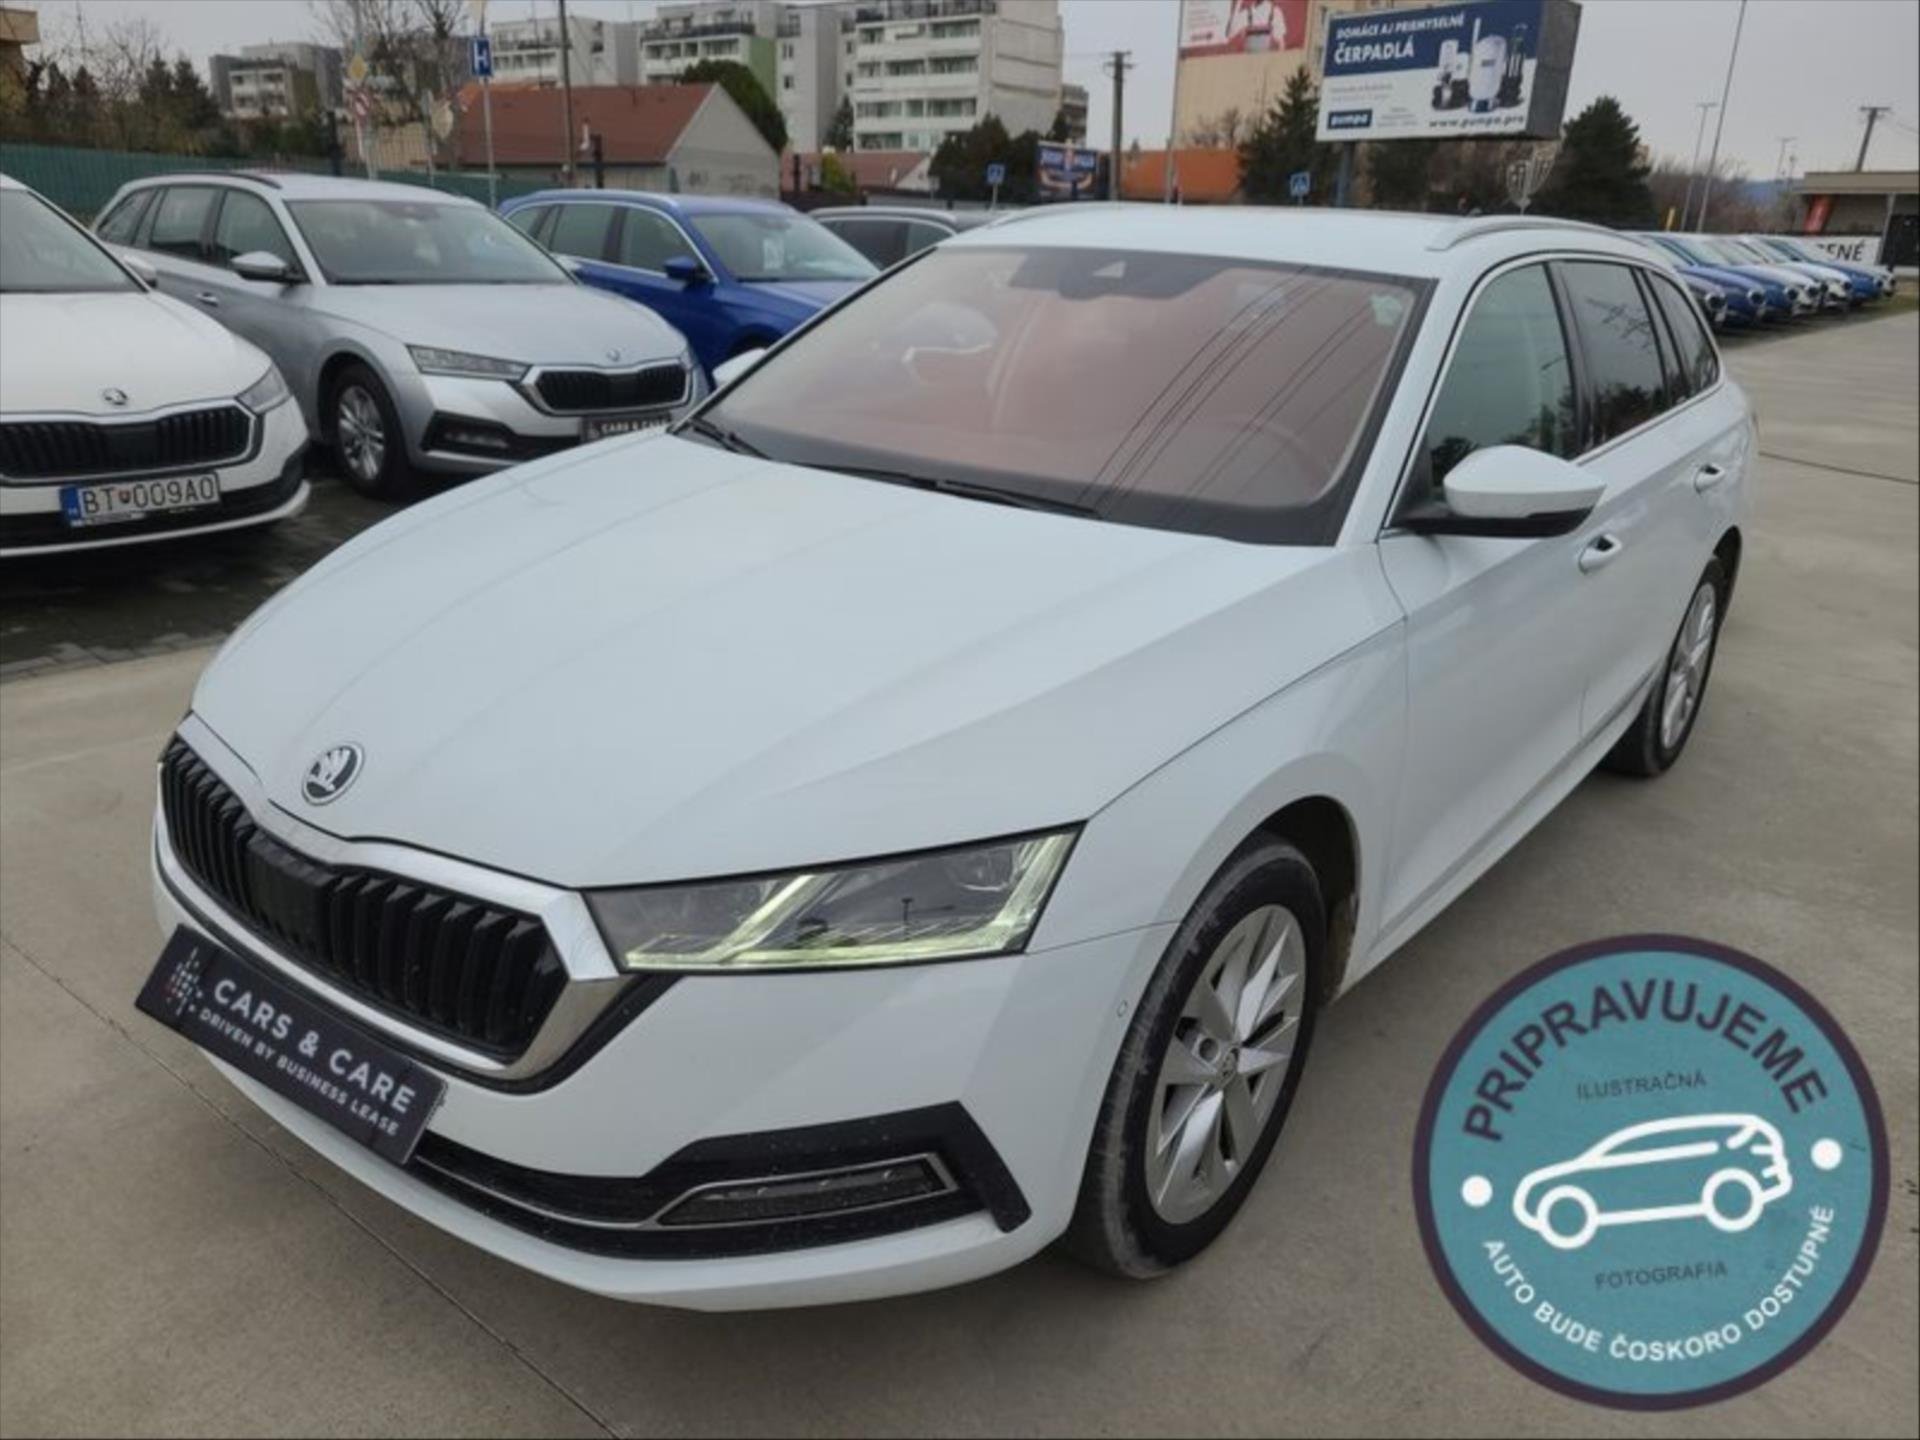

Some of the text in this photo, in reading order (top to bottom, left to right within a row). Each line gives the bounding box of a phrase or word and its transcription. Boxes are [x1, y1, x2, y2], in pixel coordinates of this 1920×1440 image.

[473, 40, 489, 72] H
[1334, 35, 1415, 64] ČERPADLÁ
[82, 486, 114, 514] BT
[214, 979, 416, 1114] CARS & CARE
[200, 1007, 401, 1137] DRIVEN BY BUSINESS LEASE
